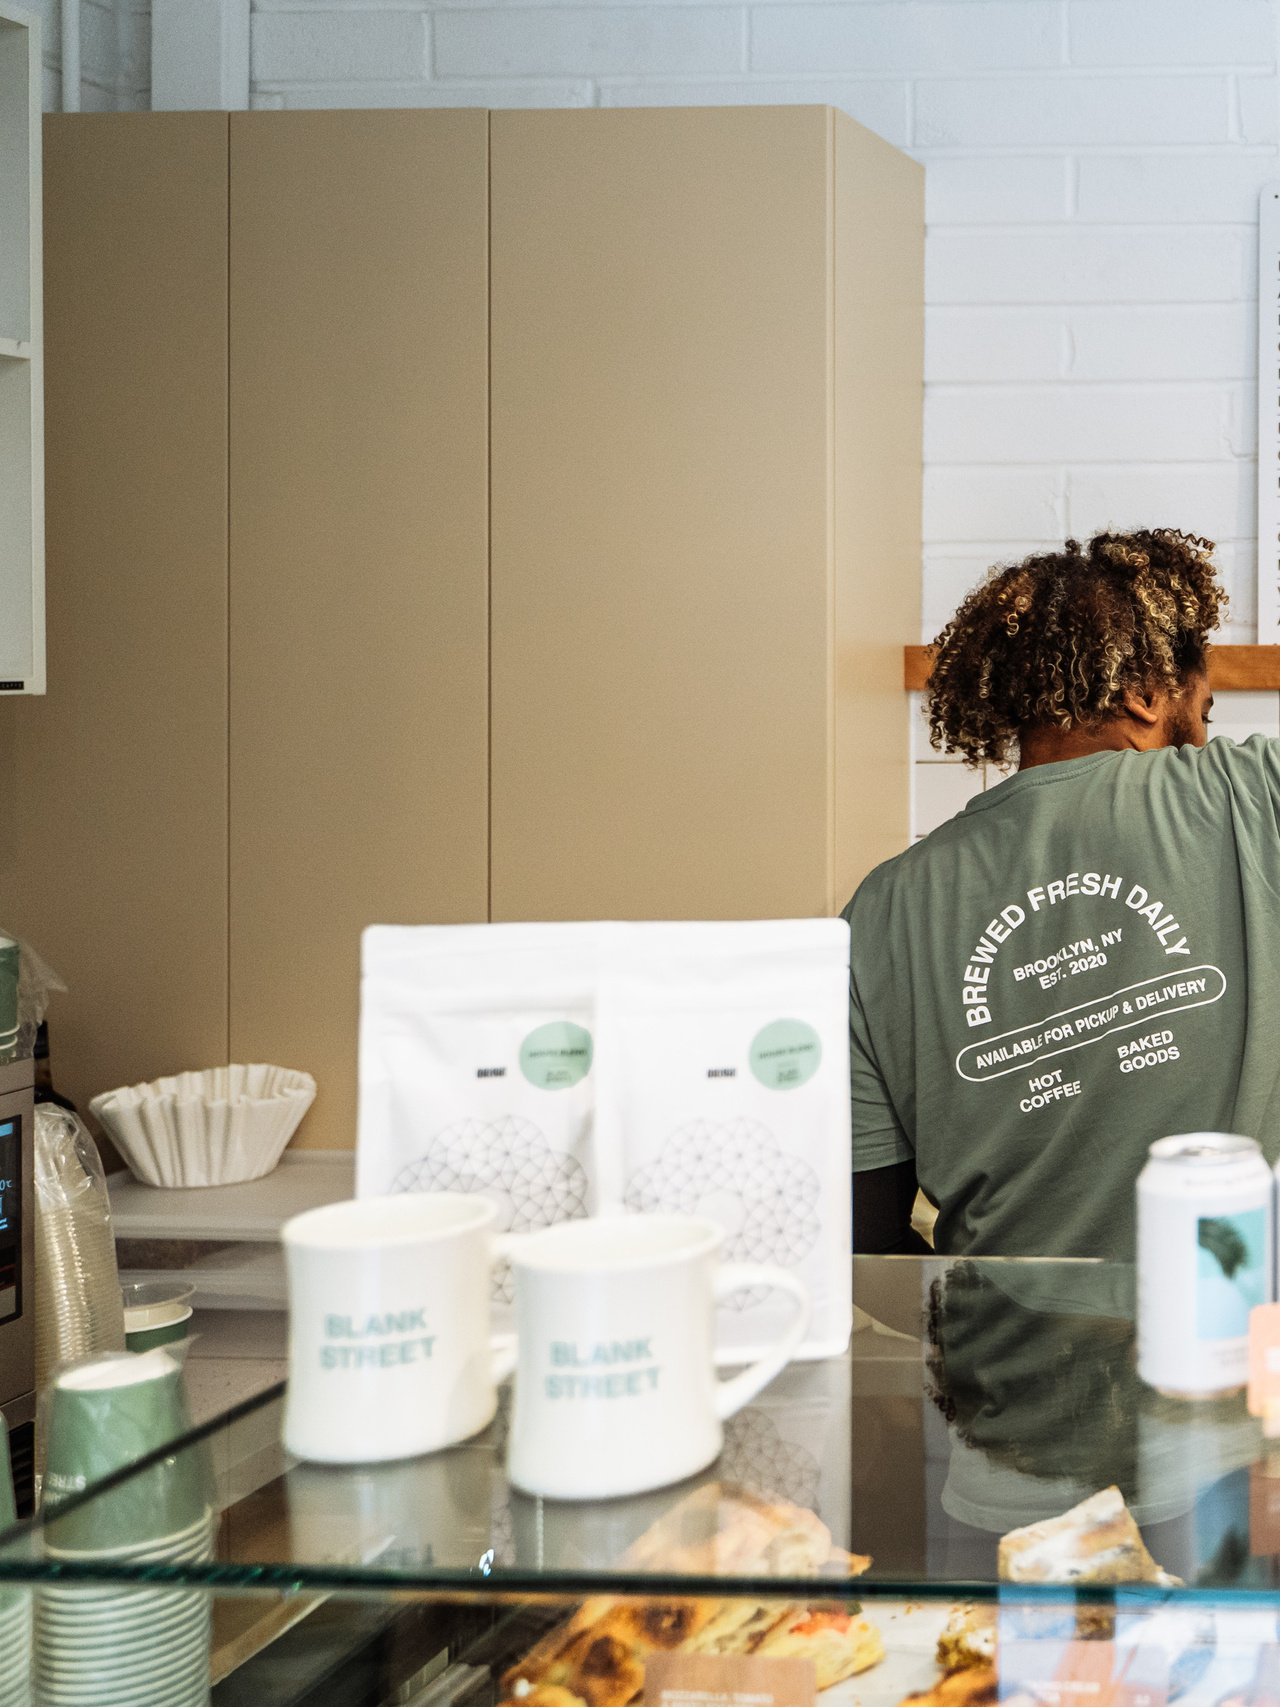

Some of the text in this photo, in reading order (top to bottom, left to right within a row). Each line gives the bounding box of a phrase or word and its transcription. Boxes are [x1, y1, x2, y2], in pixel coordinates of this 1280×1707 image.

[962, 872, 1191, 1027] BREWED FRESH DAILY
[1013, 928, 1123, 982] BROOKLYN, NY
[1039, 952, 1108, 990] EST. 2020
[976, 978, 1207, 1069] AVAILABLE FOR PICKUP & DELIVERY
[1116, 1030, 1174, 1059] BAKED
[1119, 1046, 1181, 1073] GOODS
[1019, 1080, 1082, 1113] COFFEE
[1028, 1069, 1063, 1093] HOT
[324, 1307, 427, 1340] BLANK
[319, 1335, 438, 1371] STREET
[548, 1336, 654, 1368] BLANK
[543, 1366, 664, 1401] STREET
